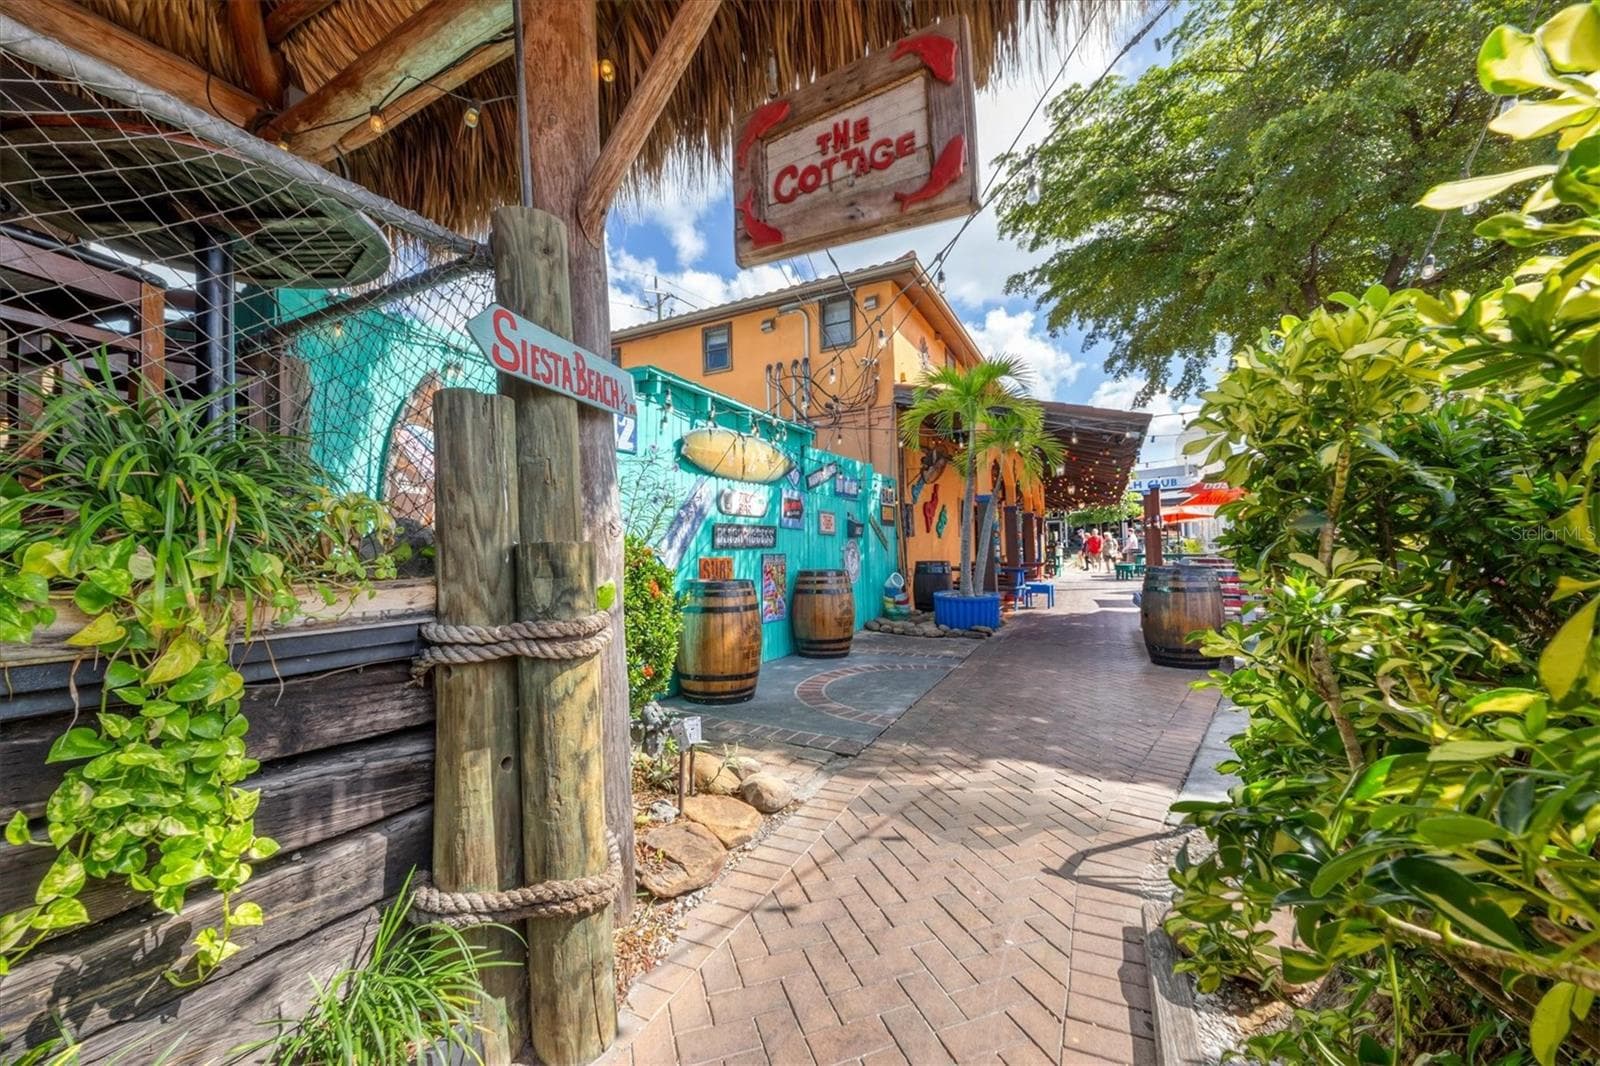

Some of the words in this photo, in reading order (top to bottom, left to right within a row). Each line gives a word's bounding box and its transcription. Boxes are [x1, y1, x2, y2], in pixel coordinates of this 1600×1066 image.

[774, 132, 915, 203] COTTAGE
[816, 116, 870, 155] THE
[492, 309, 574, 392] SIESTA
[574, 350, 619, 410] BEACH
